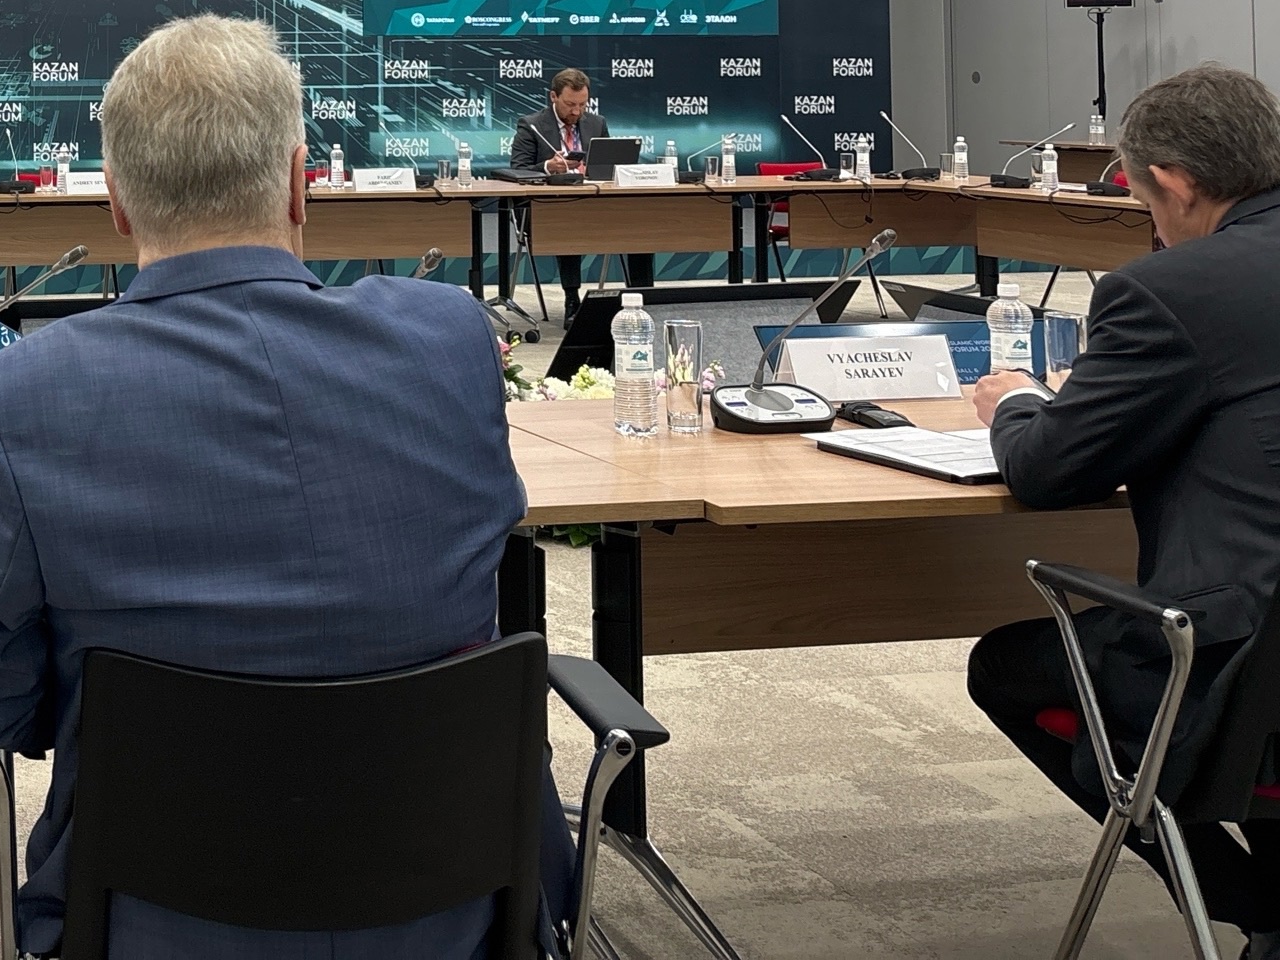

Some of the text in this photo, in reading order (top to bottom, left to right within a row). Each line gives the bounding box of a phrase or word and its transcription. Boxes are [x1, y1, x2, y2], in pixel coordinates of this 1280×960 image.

[32, 62, 78, 72] KAZAN
[384, 60, 428, 70] KAZAN
[500, 60, 542, 69] KAZAN
[612, 59, 654, 68] KAZAN
[720, 58, 761, 67] KAZAN
[833, 58, 873, 67] KAZAN
[384, 70, 428, 79] FORUM
[500, 69, 542, 78] FORUM
[612, 68, 654, 77] FORUM
[720, 67, 761, 76] FORUM
[833, 67, 873, 76] FORUM
[32, 72, 78, 82] FORUM
[443, 99, 486, 108] KAZAN
[667, 97, 708, 106] KAZAN
[795, 96, 835, 105] KAZAN
[443, 108, 486, 117] FORUM
[667, 106, 708, 115] FORUM
[795, 105, 835, 114] FORUM
[826, 351, 913, 364] VYACHESLAV
[844, 367, 904, 379] SARAYEV
